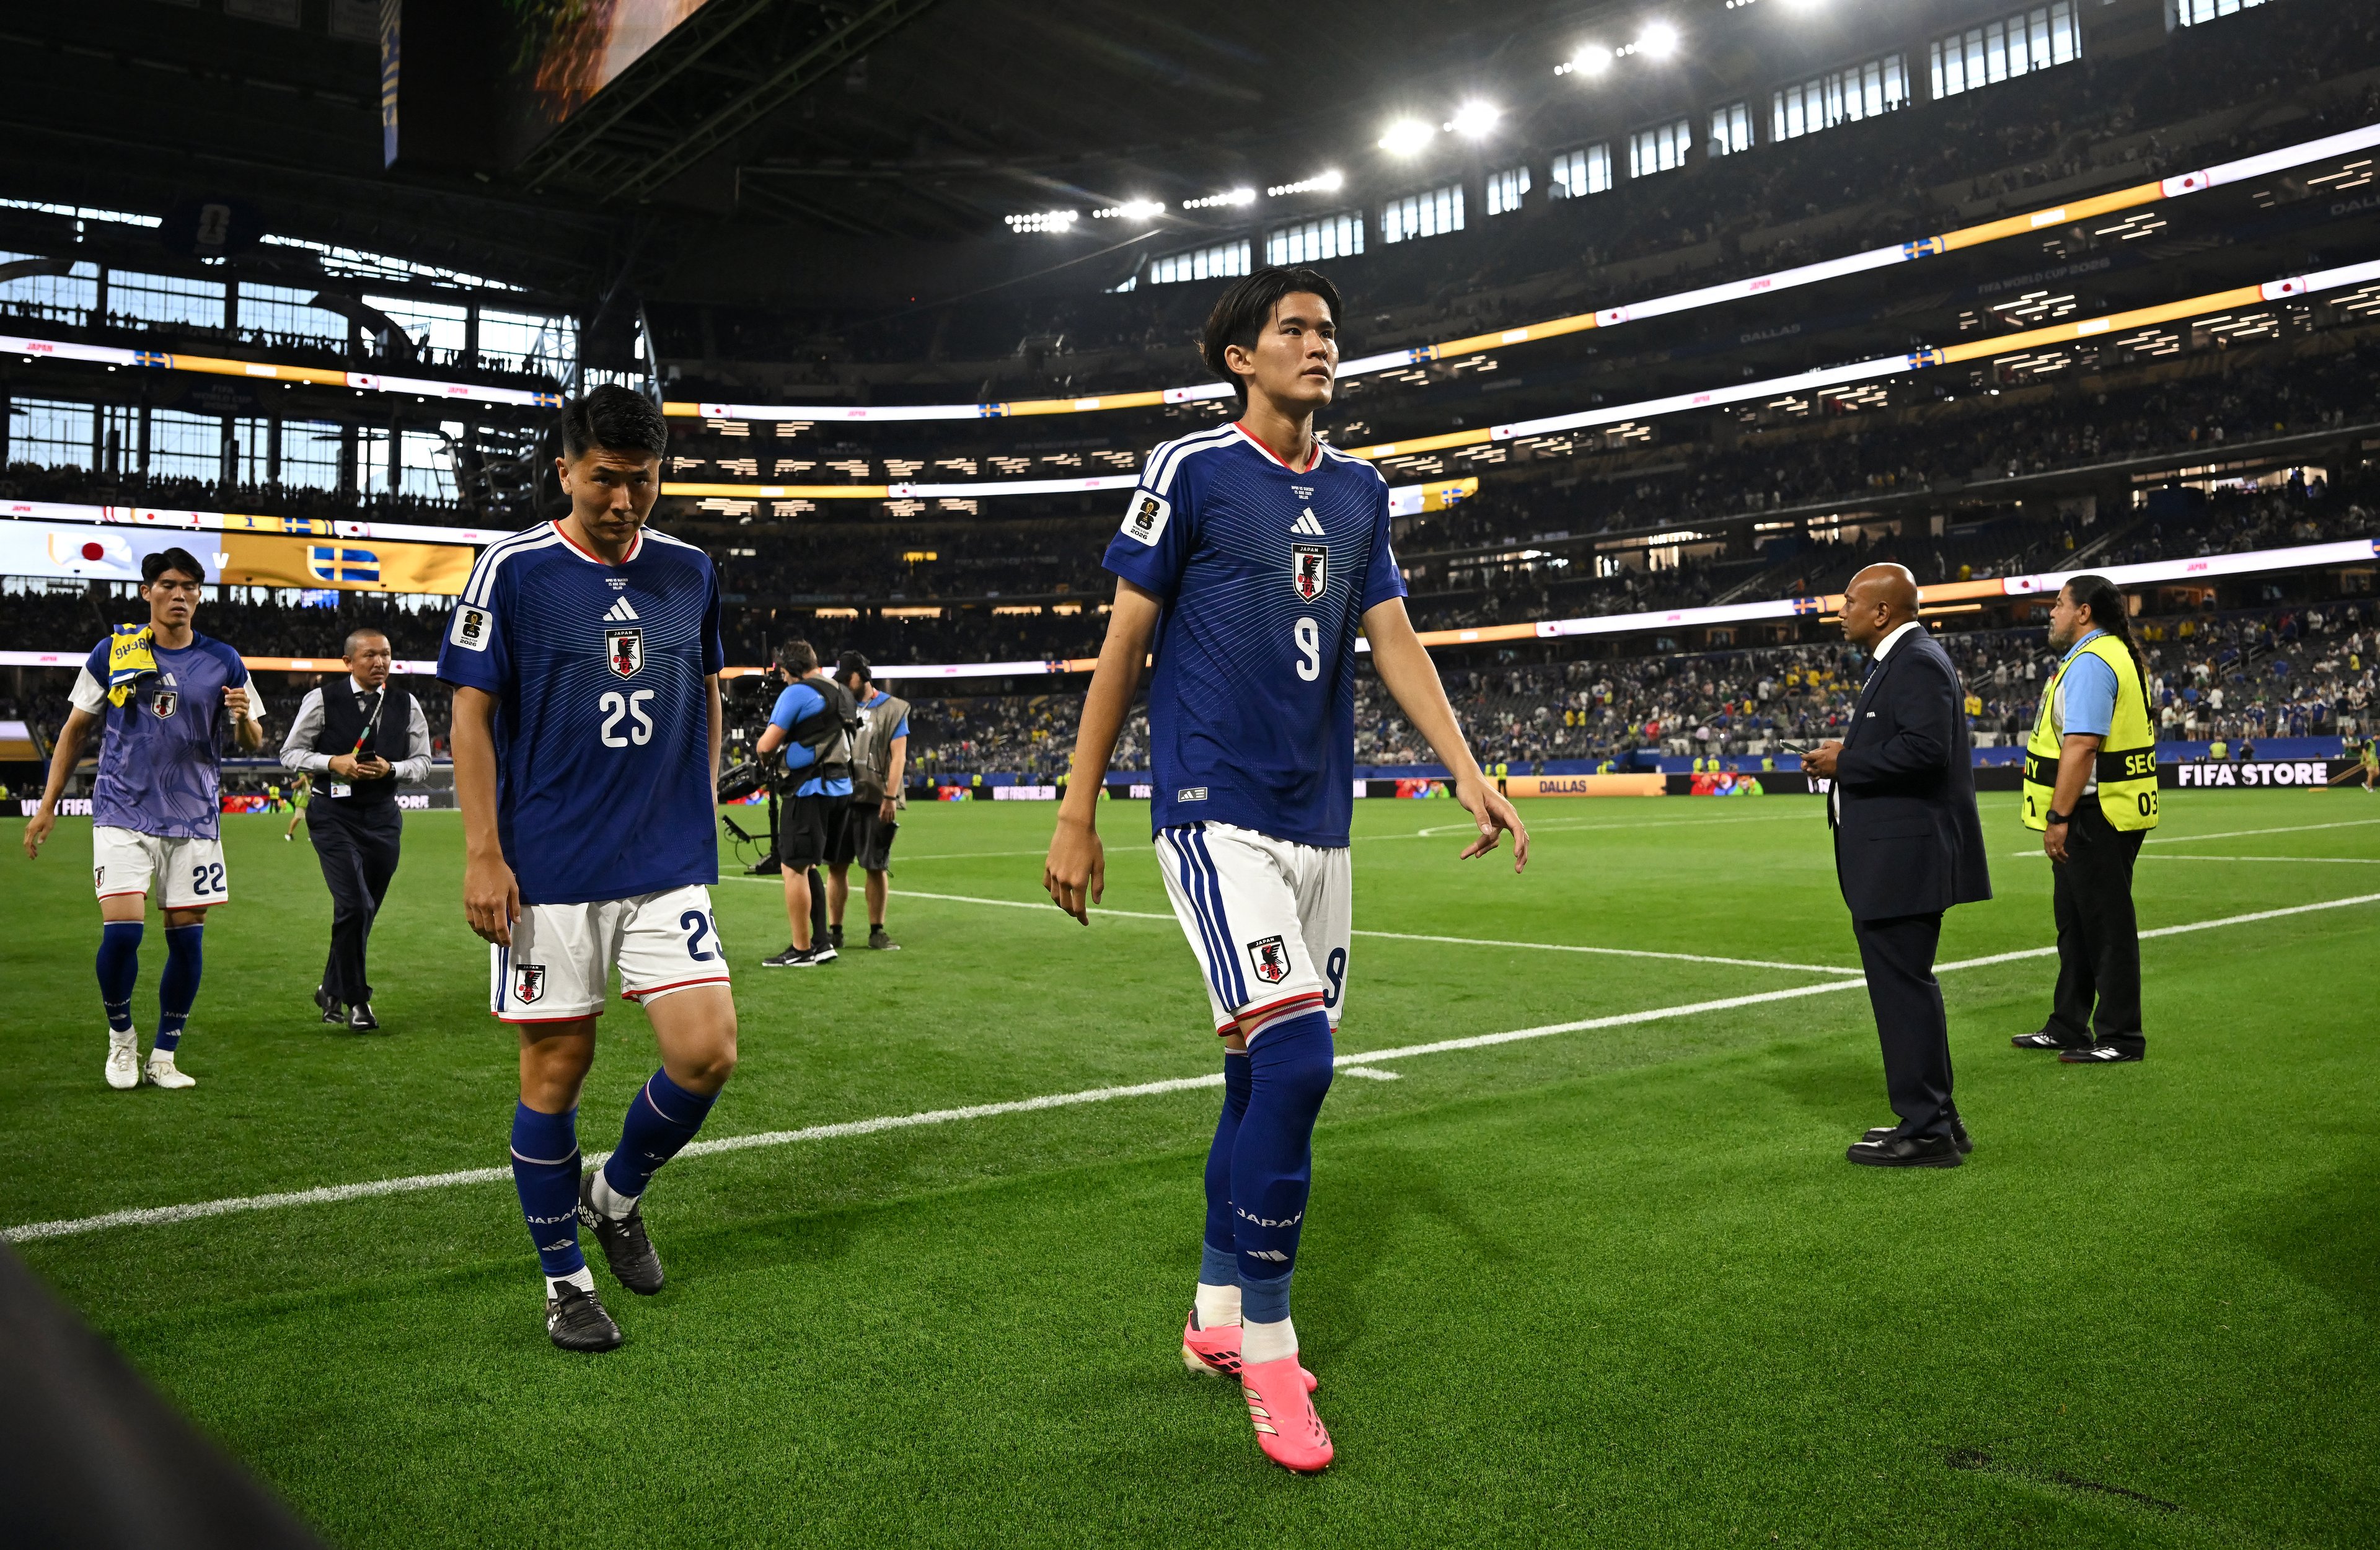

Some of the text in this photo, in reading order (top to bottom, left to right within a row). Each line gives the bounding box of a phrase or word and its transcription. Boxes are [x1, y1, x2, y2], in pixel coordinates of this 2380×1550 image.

[1740, 323, 1801, 343] DALLAS
[191, 514, 201, 524] 1
[245, 517, 255, 527] 1
[1130, 529, 1147, 539] 2026
[1301, 584, 1316, 592] JFA
[1294, 617, 1320, 682] 9
[617, 663, 633, 671] JFA
[599, 689, 654, 748] 25
[2178, 762, 2328, 786] FIFA STORE
[1540, 780, 1587, 793] DALLAS
[2138, 791, 2157, 817] 03
[193, 862, 226, 895] 22
[1255, 937, 1275, 946] JAPAN
[1267, 968, 1283, 979] JFA
[1323, 947, 1346, 1008] 9
[527, 1205, 576, 1224] JAPAN
[1236, 1207, 1302, 1227] JAPAN
